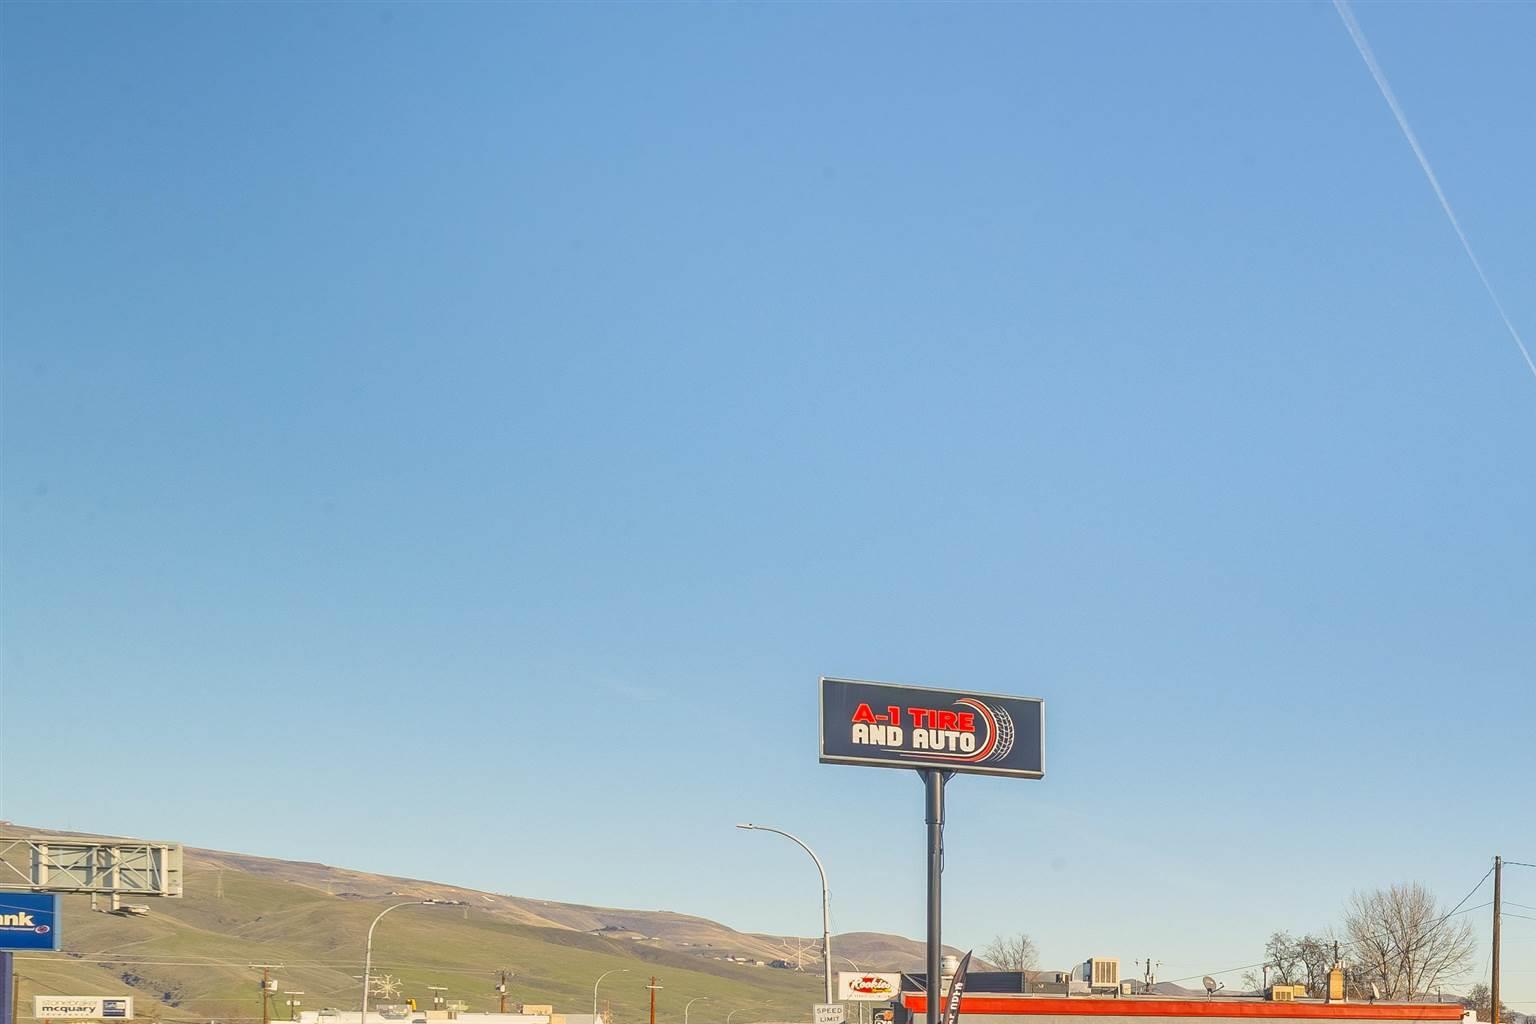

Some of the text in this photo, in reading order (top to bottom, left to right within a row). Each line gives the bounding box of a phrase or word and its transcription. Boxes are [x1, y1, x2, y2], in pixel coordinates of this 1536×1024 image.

[852, 703, 976, 732] A-1 TIRE
[852, 724, 976, 752] AND AUTO
[0, 911, 35, 926] nk
[42, 1005, 96, 1014] mcquary
